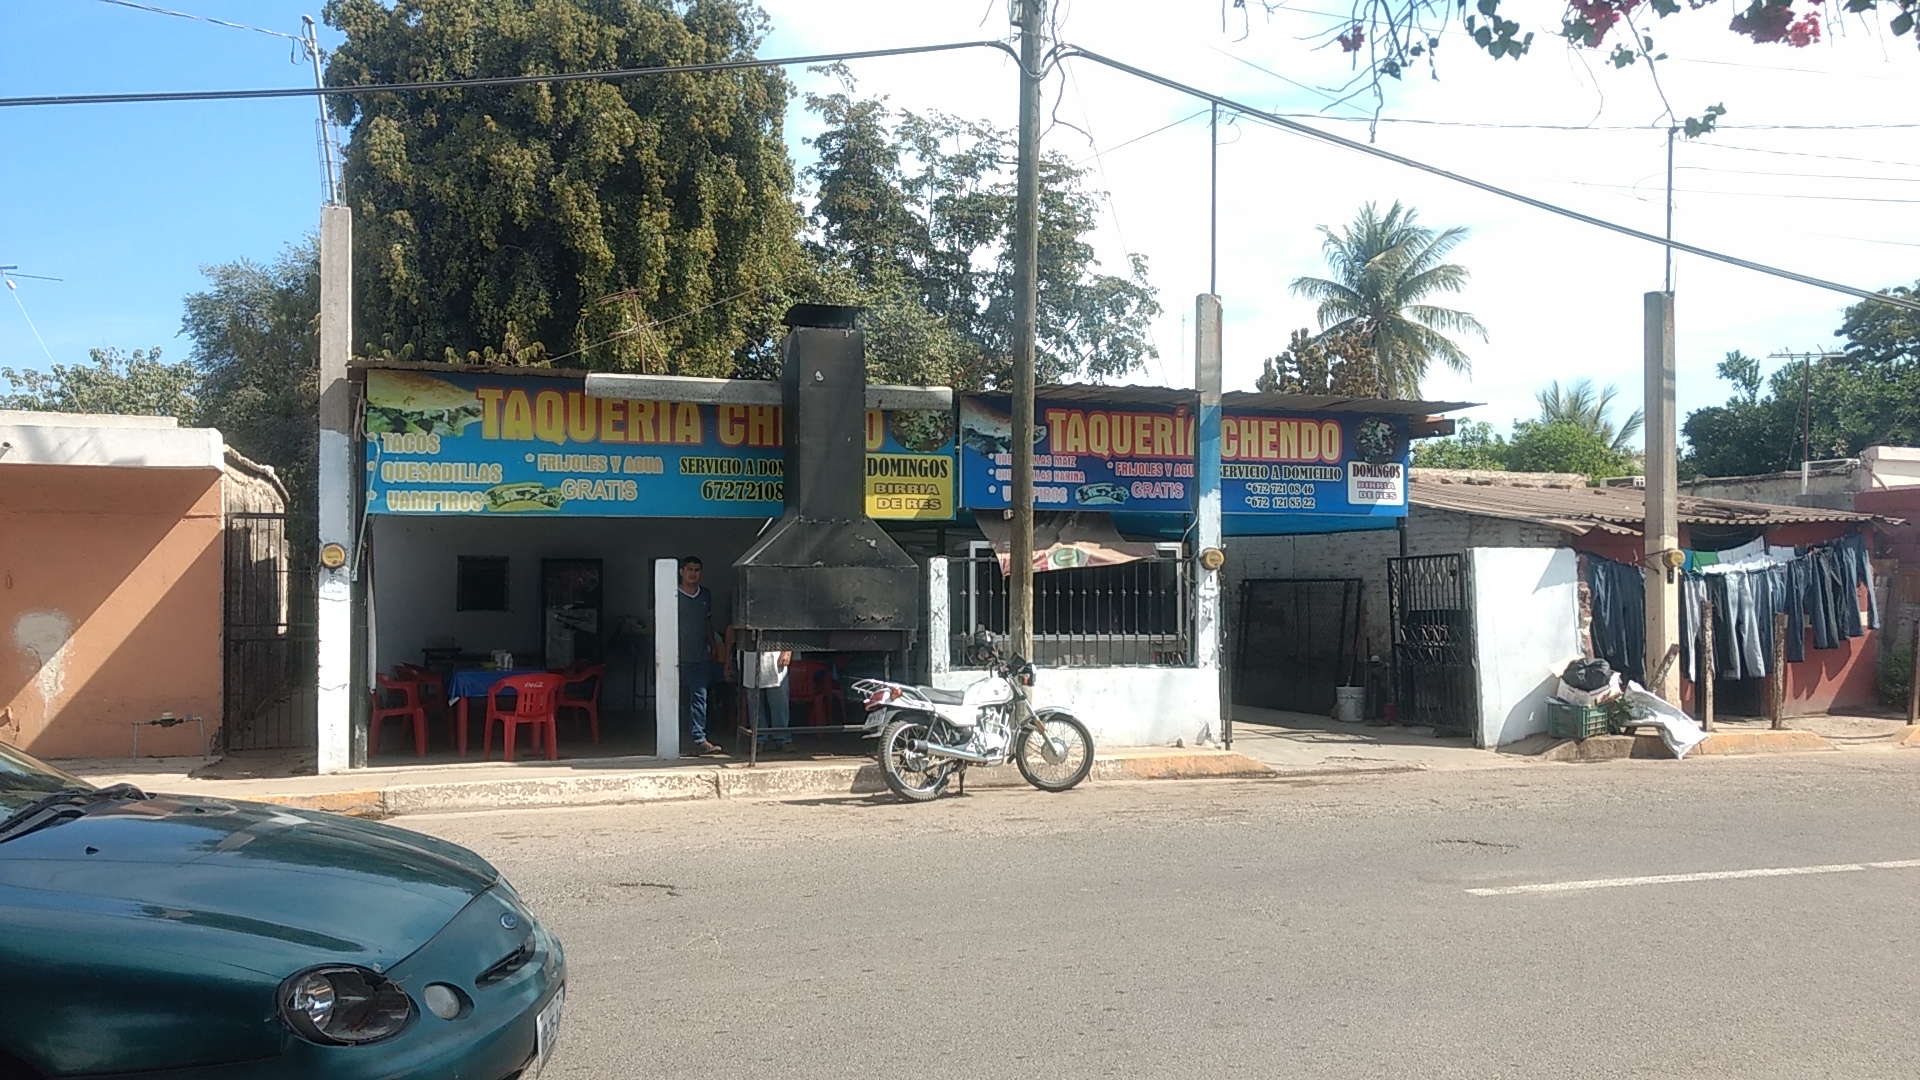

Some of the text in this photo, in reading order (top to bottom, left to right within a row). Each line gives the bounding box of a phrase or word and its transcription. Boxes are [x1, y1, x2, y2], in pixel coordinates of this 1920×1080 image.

[382, 433, 440, 454] TACOS
[1221, 416, 1342, 463] CHENDO
[538, 453, 663, 474] FRIJOLES Y AGUA
[680, 457, 741, 476] SERVICIO
[745, 458, 755, 476] A
[867, 458, 948, 478] DOMINGOS
[1053, 455, 1076, 467] MAIZ
[1115, 461, 1164, 477] FRIJOLES
[1165, 463, 1172, 477] Y
[381, 462, 502, 484] QUESADILLAS
[1053, 470, 1085, 483] HARINA
[1270, 465, 1281, 480] A
[1283, 465, 1342, 481] DOMICILIO
[1352, 463, 1400, 479] DOMINGOS
[561, 479, 637, 500] GRATIS
[874, 483, 939, 495] BIRRIA
[1131, 481, 1184, 499] GRATIS
[1270, 482, 1287, 494] 721
[1289, 483, 1301, 494] 08
[1302, 483, 1314, 495] 46
[1356, 481, 1395, 490] BIRRIA
[387, 490, 484, 511] VAMPIROS
[1002, 485, 1068, 503] VPIROS
[1358, 491, 1397, 500] DE RES
[877, 498, 941, 510] DE RES
[1272, 498, 1288, 509] 121
[1302, 498, 1315, 509] 22
